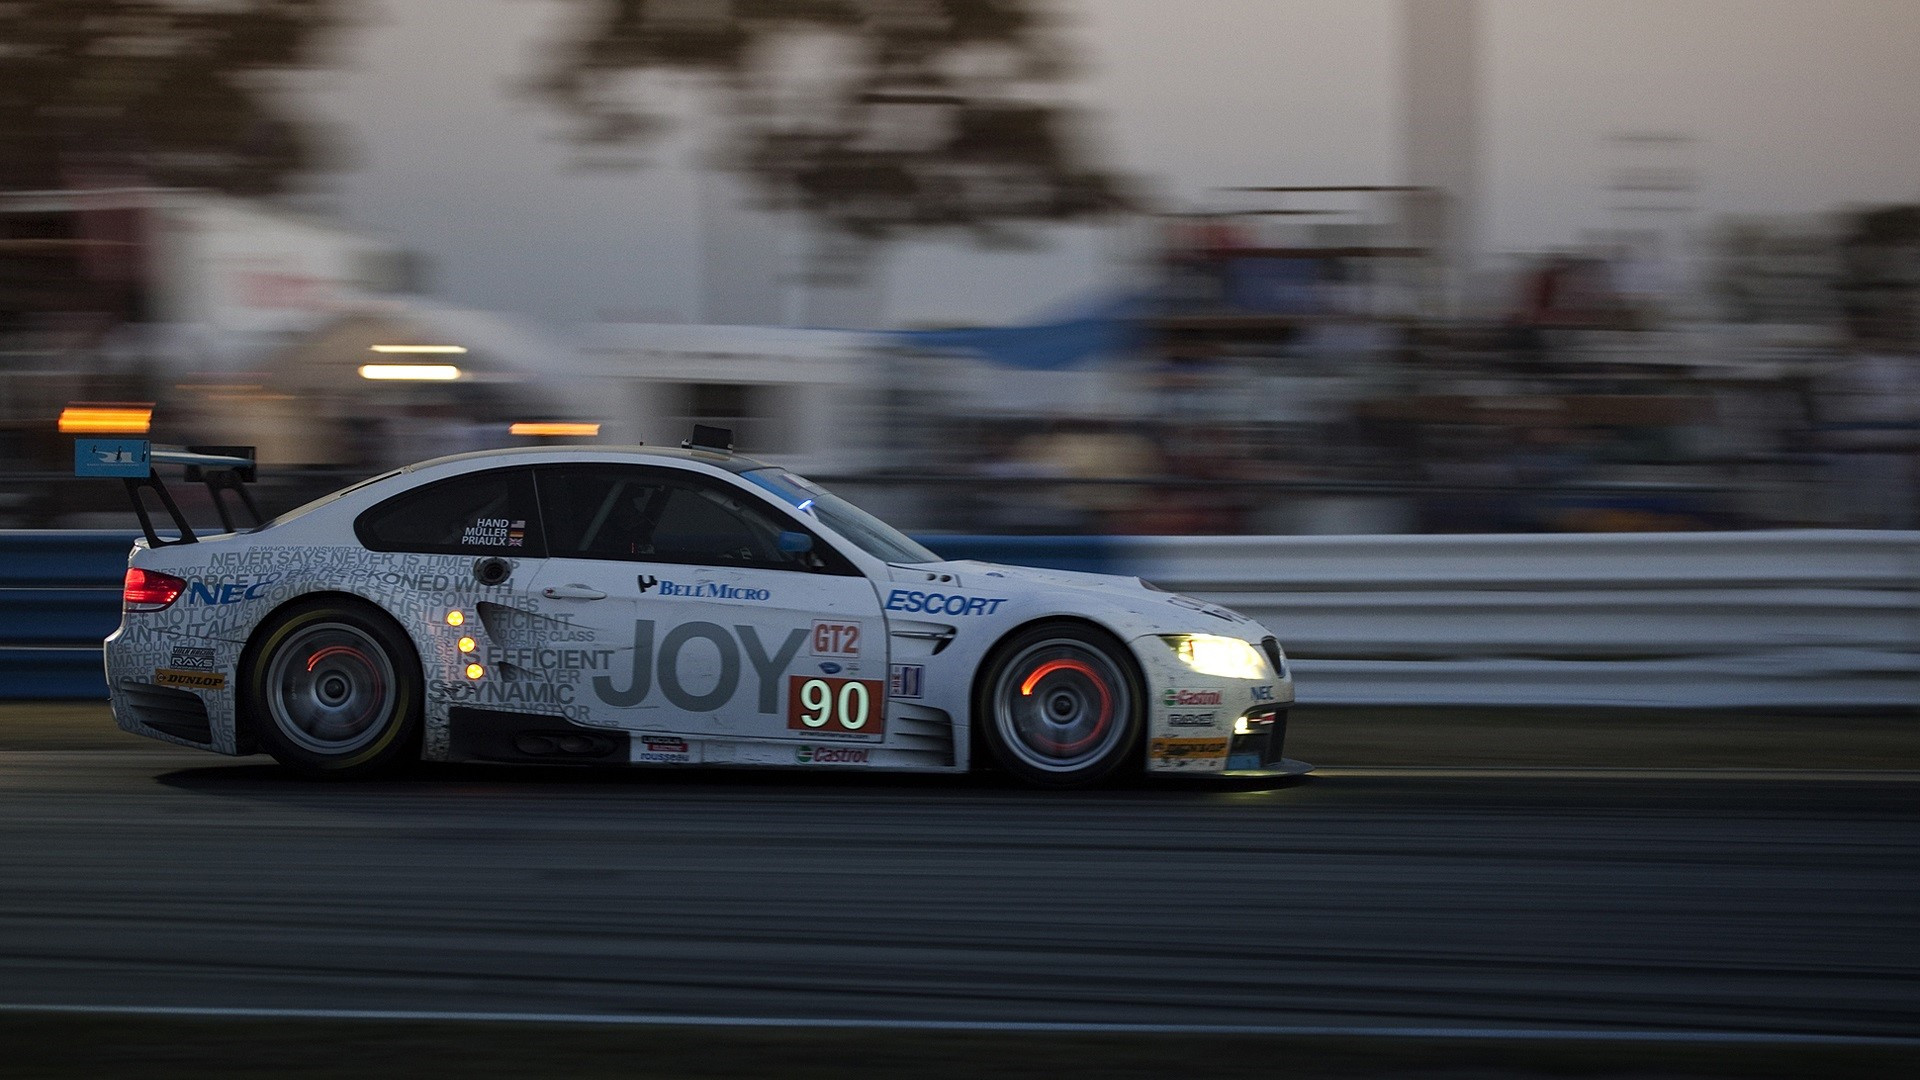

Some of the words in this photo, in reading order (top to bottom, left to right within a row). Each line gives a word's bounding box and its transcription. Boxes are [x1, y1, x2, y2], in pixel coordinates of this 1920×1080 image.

[477, 518, 509, 528] HAND
[465, 526, 508, 537] MÜLLER
[461, 535, 506, 546] PRIAULX
[210, 551, 272, 566] NEVER
[276, 550, 327, 565] SAYS
[328, 551, 394, 566] NEVER
[402, 553, 420, 566] IS
[178, 566, 205, 576] NOT
[206, 563, 294, 575] COMPROMISE
[388, 564, 415, 575] CAN
[418, 565, 435, 575] BE
[438, 566, 474, 577] COUN
[190, 581, 273, 605] NEC
[885, 589, 1007, 617] ESCORT
[154, 607, 199, 626] NOT
[550, 630, 596, 643] CLASS
[815, 623, 859, 654] GT2
[171, 656, 214, 667] RAYS
[487, 647, 615, 670] EFFICIENT
[592, 619, 812, 715] JOY
[167, 674, 223, 687] DUNLOP
[516, 667, 582, 684] NEVER
[450, 680, 576, 705] DYNAMIC
[1250, 685, 1274, 700] NEC
[800, 677, 870, 731] 90
[640, 753, 689, 762] rousseau
[814, 746, 870, 763] Castrol
